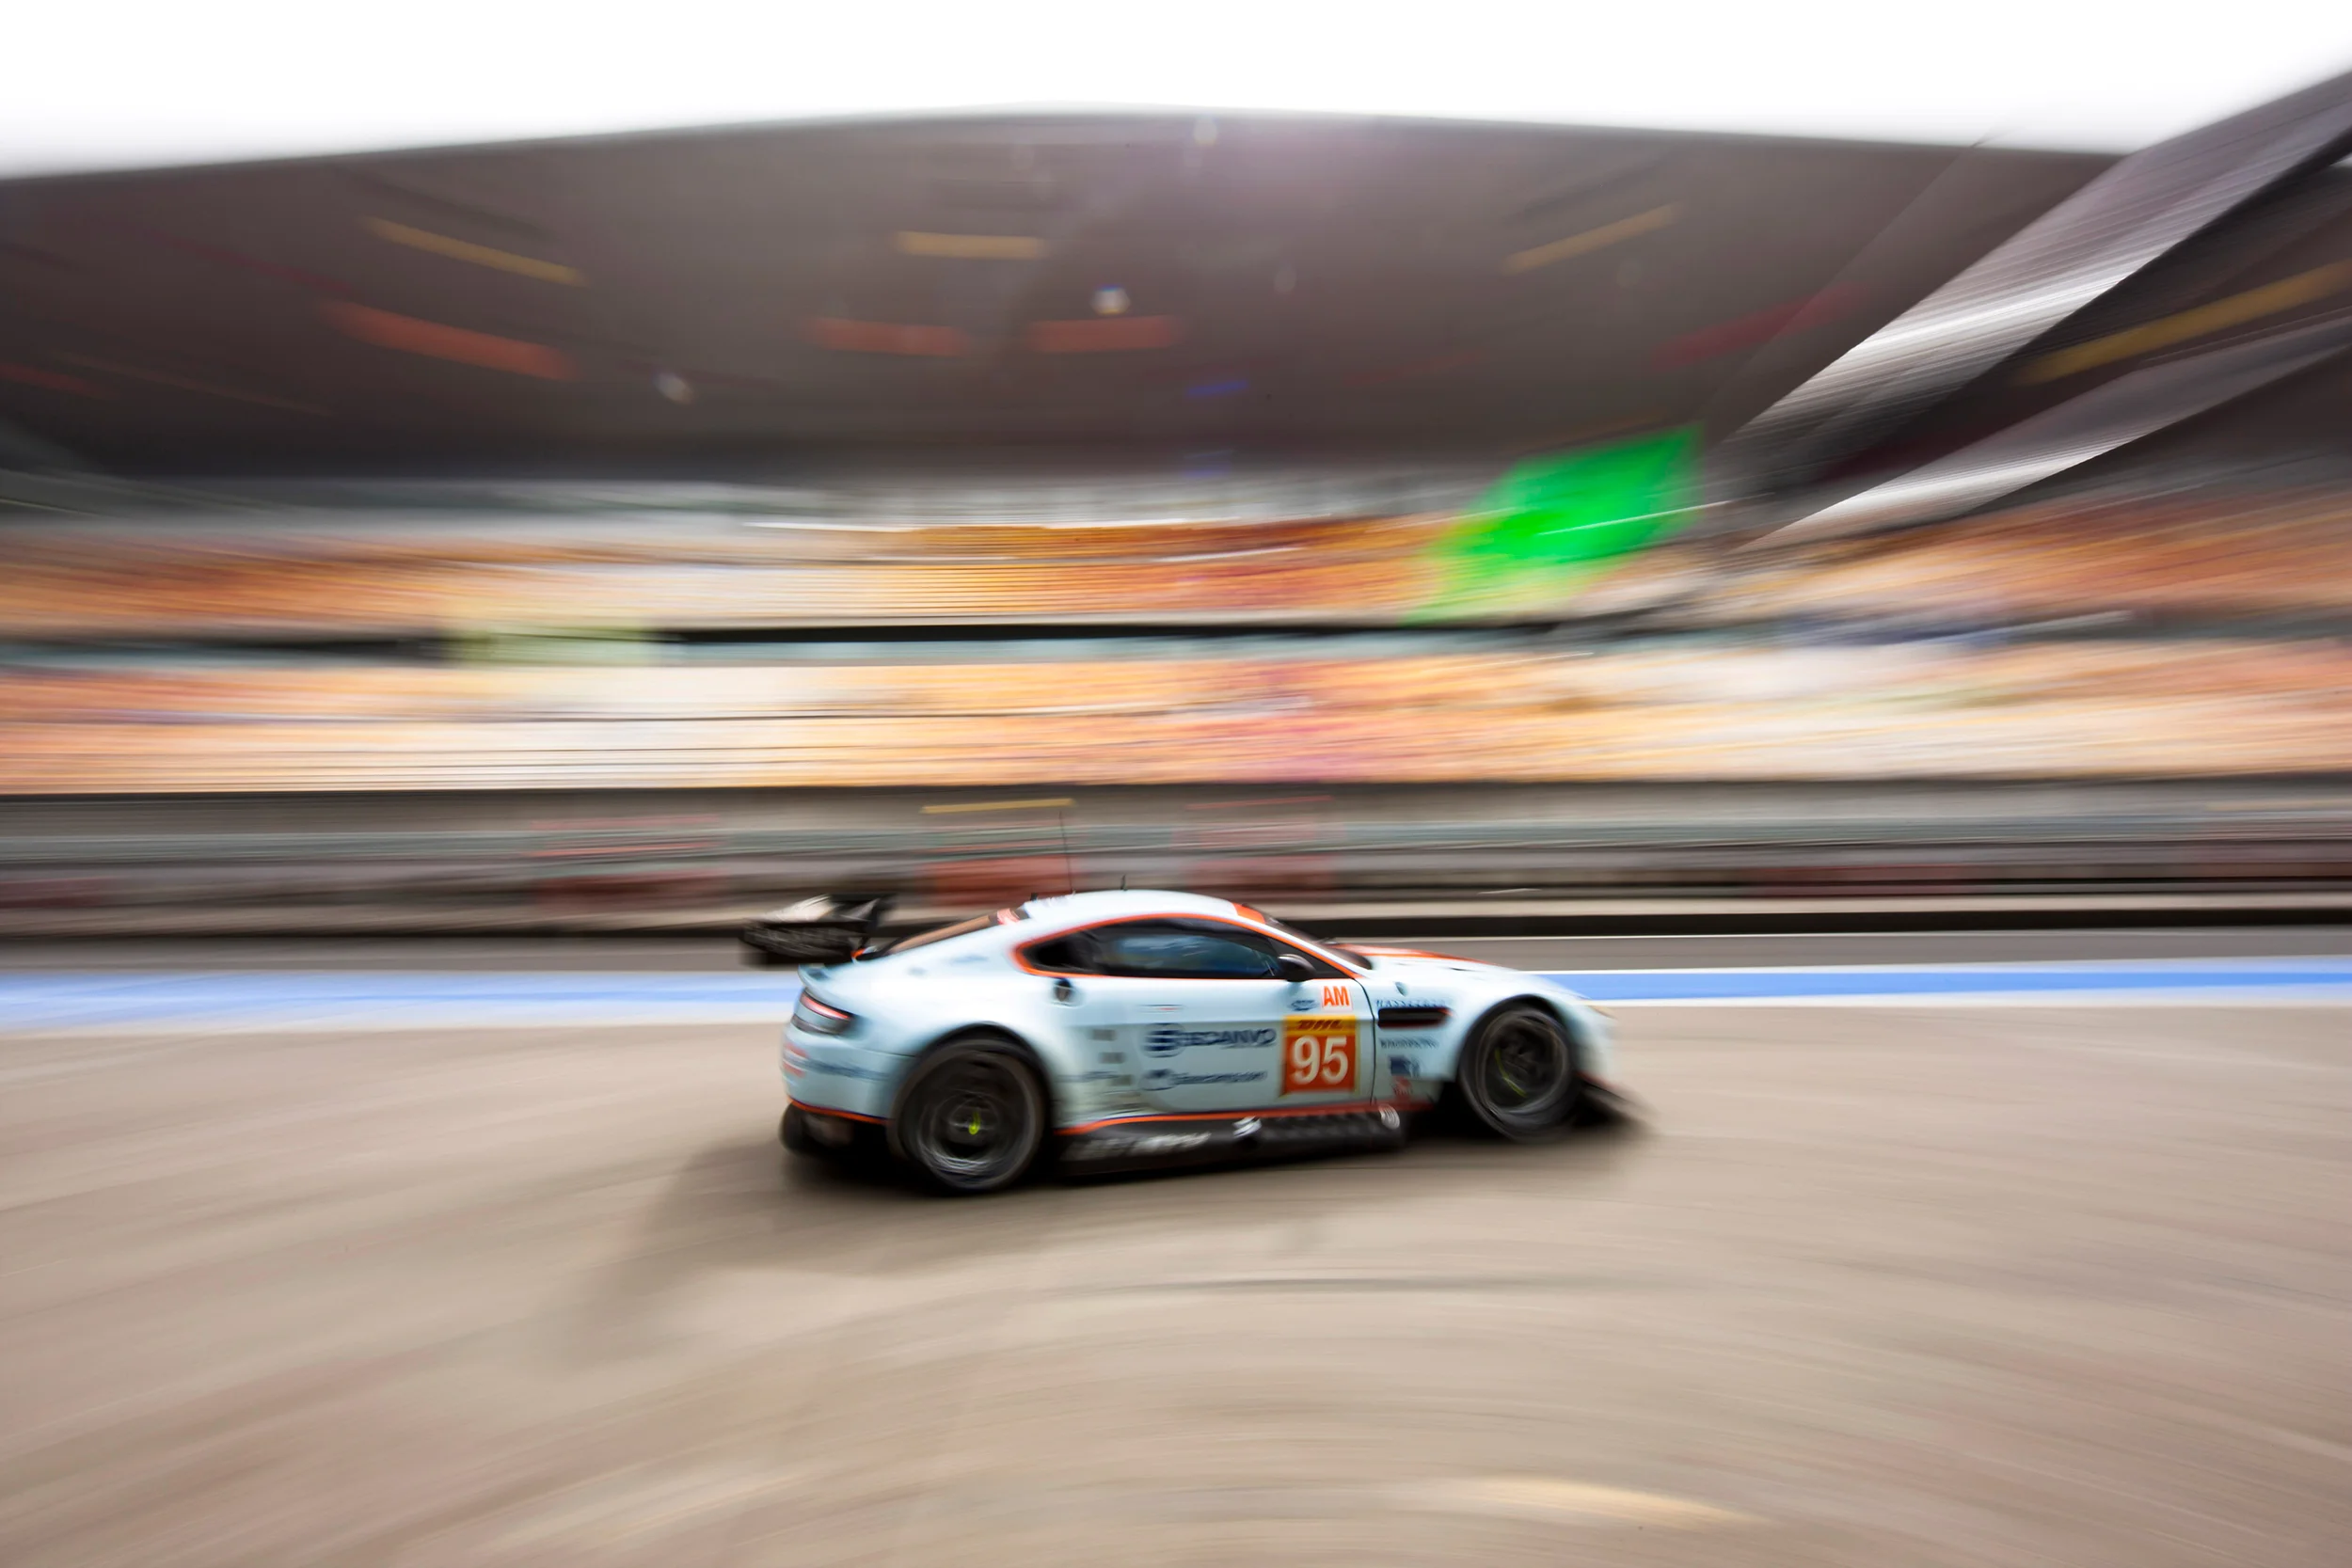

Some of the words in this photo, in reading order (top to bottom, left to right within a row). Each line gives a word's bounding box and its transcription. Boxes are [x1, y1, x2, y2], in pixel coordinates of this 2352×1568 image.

[1323, 986, 1350, 1006] AM
[1296, 1019, 1343, 1030] DHL
[1294, 1036, 1349, 1085] 95
